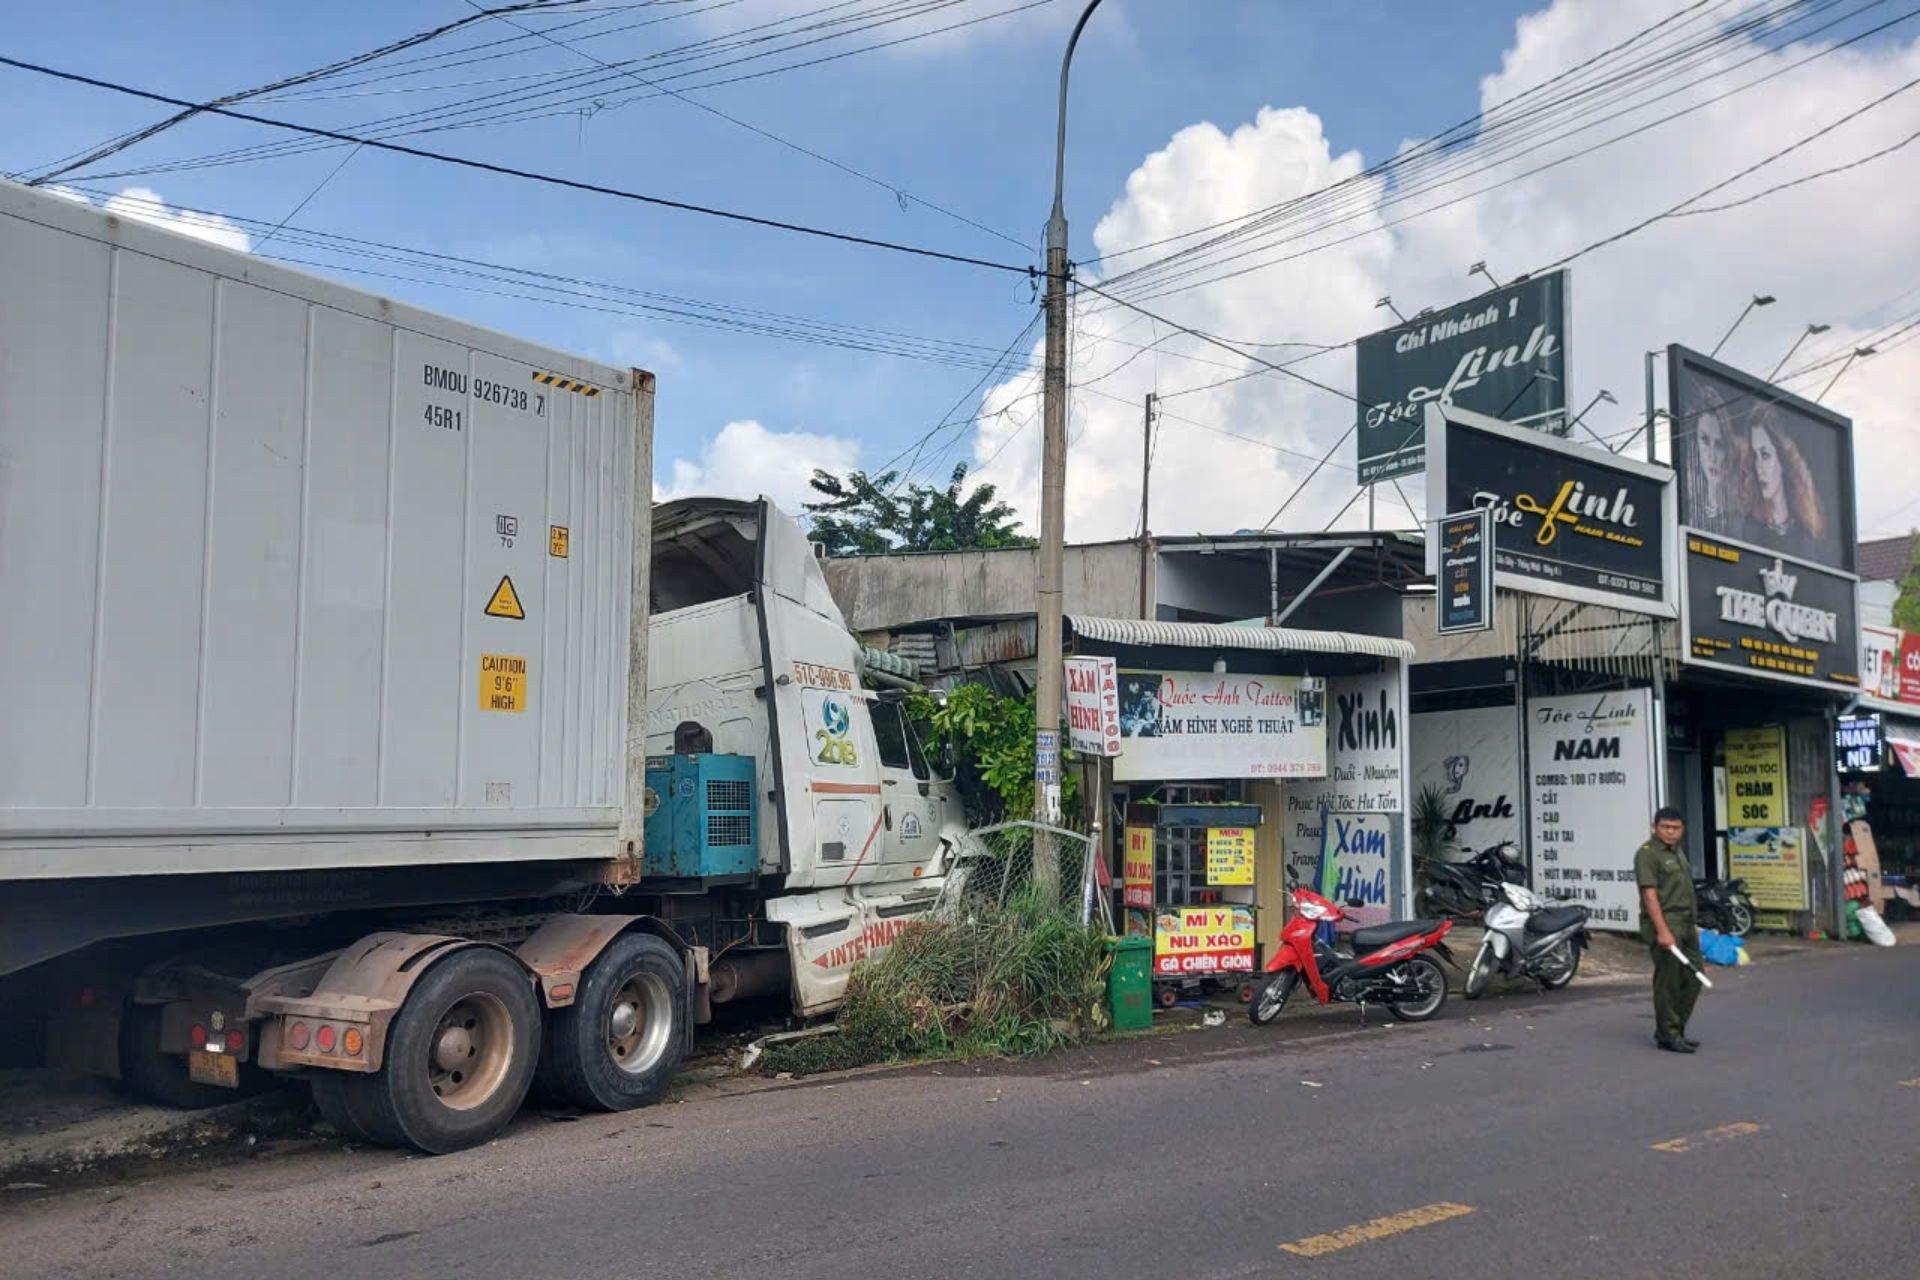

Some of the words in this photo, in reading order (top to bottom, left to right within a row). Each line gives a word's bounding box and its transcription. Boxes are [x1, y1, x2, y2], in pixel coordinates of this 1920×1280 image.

[1395, 326, 1427, 353] Chi
[1430, 304, 1499, 344] Nhánh
[1508, 296, 1519, 318] 1
[1366, 401, 1418, 429] Tóc
[1408, 324, 1561, 406] Linh
[424, 364, 467, 394] BMOU
[473, 378, 528, 411] 926738
[536, 395, 545, 416] 7
[424, 404, 461, 432] 45R1
[1516, 480, 1638, 545] Linh
[501, 537, 513, 548] 70
[1605, 532, 1643, 547] SALON
[1716, 585, 1766, 628] THE
[1766, 598, 1837, 643] QUEEN
[482, 656, 526, 674] CAUTION
[1068, 662, 1097, 694] XĂM
[491, 694, 515, 710] HIGH
[1156, 677, 1197, 709] Quốc
[1245, 679, 1294, 706] Tattoo
[1069, 700, 1101, 733] HÌNH
[1101, 662, 1121, 753] TATTOO
[1337, 688, 1396, 753] Xinh
[1576, 694, 1637, 734] Linh
[1153, 715, 1183, 735] XĂM
[1186, 713, 1218, 735] HÌNH
[1221, 713, 1254, 738] NGHỆ
[1257, 713, 1296, 738] THUẬT
[1841, 728, 1876, 747] NAM
[1553, 736, 1621, 762] NAM
[1570, 773, 1586, 786] 100
[1729, 765, 1758, 776] SALON
[1759, 763, 1779, 775] TÓC
[1542, 789, 1558, 805] CẮT
[1736, 780, 1774, 798] CHĂM
[1287, 795, 1315, 815] Phục
[1742, 802, 1769, 820] SÓC
[1219, 829, 1244, 837] MENU
[1333, 816, 1386, 859] Xăm
[1333, 864, 1386, 905] Hình
[1169, 935, 1199, 949] NUI
